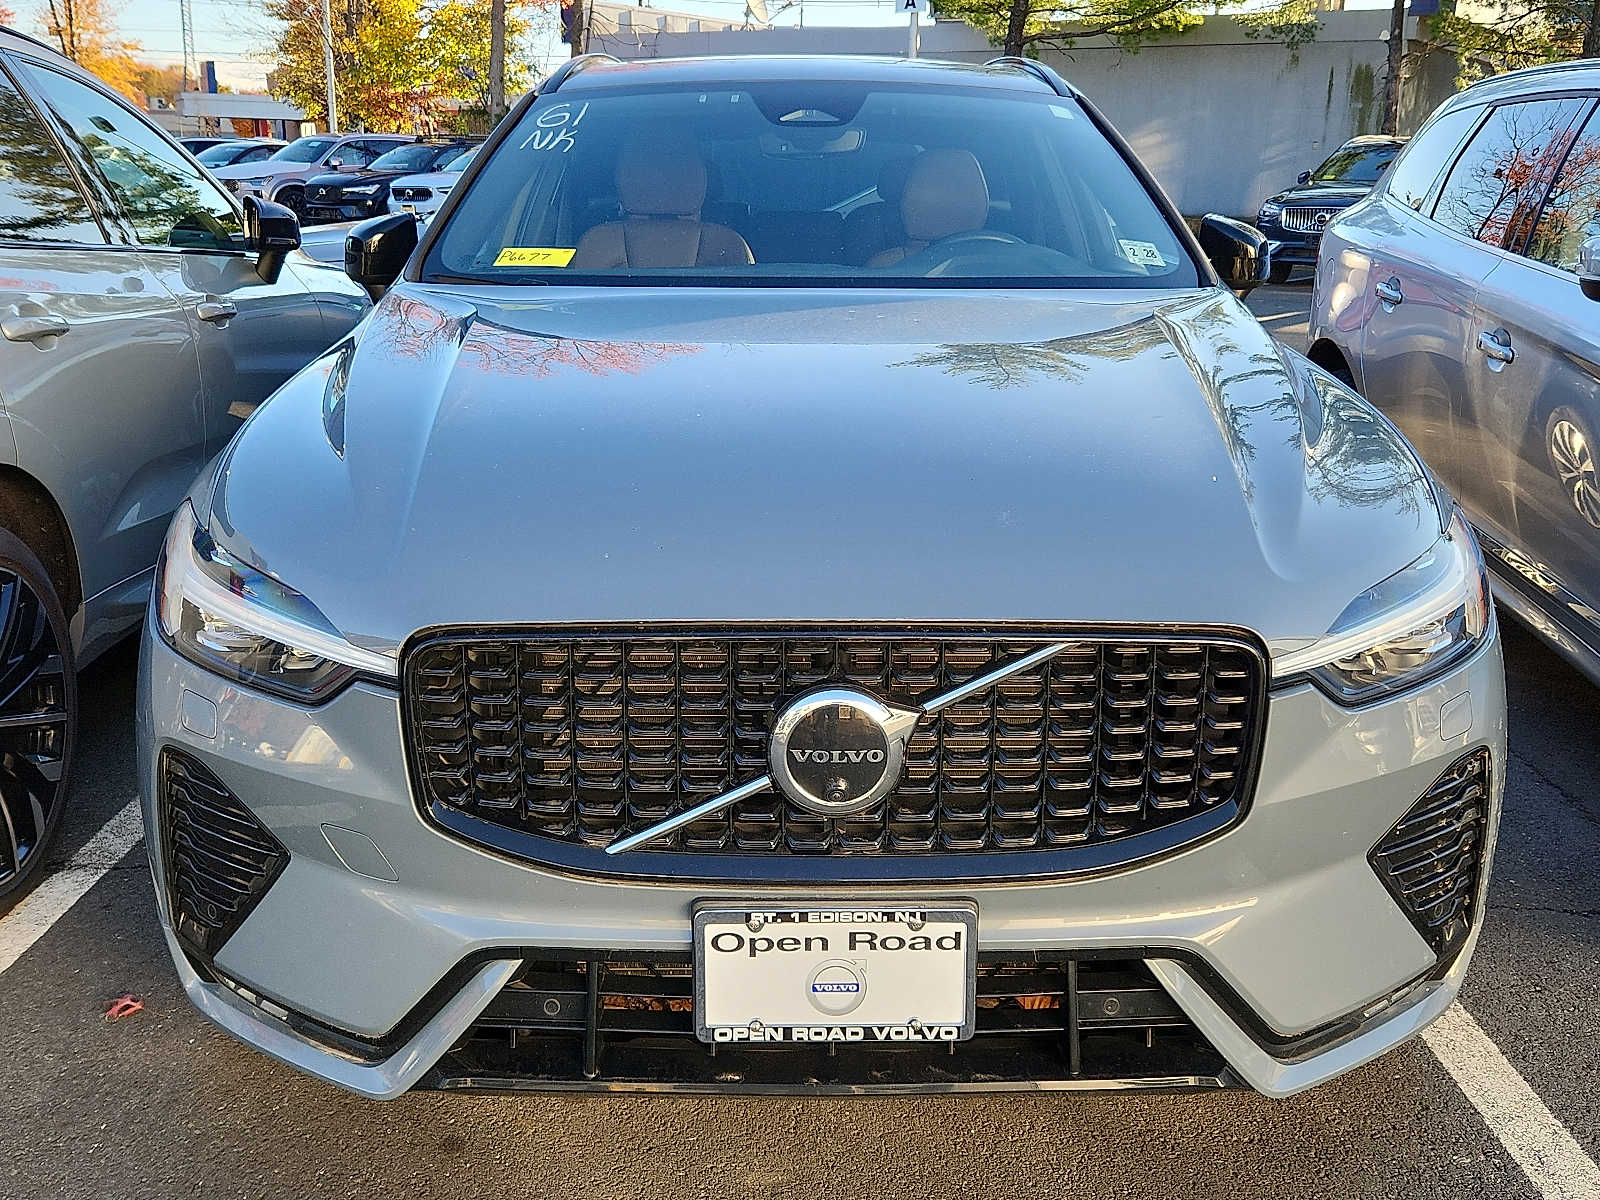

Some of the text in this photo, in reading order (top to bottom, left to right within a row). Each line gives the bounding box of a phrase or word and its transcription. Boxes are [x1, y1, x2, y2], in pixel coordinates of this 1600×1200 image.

[904, 0, 917, 9] A
[1129, 247, 1157, 258] 2 28
[790, 749, 884, 763] VOLVO
[750, 912, 782, 923] RT.
[790, 913, 800, 923] 1
[711, 931, 961, 957] Open Road
[813, 983, 858, 992] VOLVO
[714, 1027, 958, 1041] OPEN ROAD VOLVO
